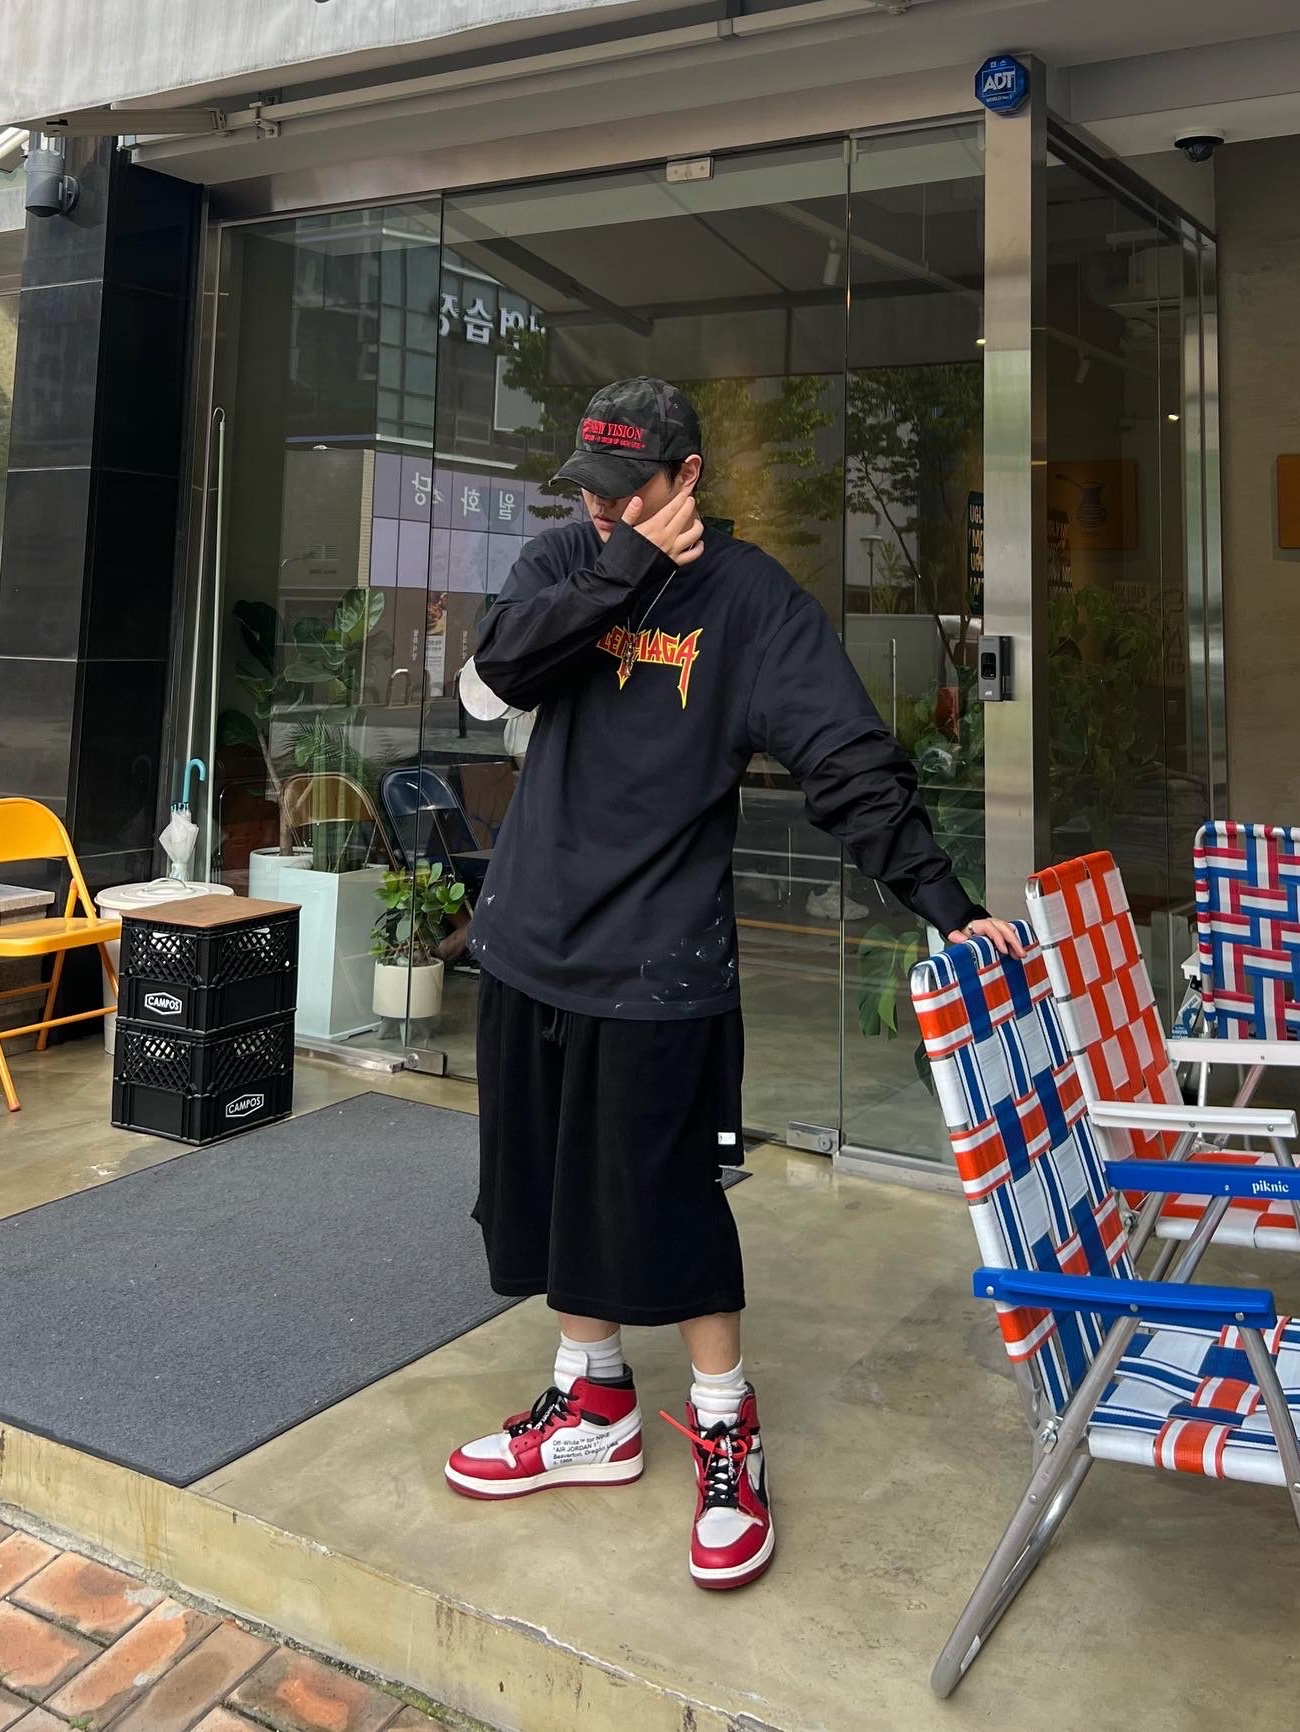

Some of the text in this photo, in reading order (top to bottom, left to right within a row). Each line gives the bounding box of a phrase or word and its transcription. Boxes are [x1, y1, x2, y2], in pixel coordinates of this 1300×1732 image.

[982, 71, 1015, 93] ADT
[607, 423, 644, 440] VISION
[148, 996, 179, 1010] CAMPOS
[228, 1096, 260, 1114] CAMPOS
[1252, 1180, 1289, 1194] piknic
[567, 1443, 592, 1452] JORDAN
